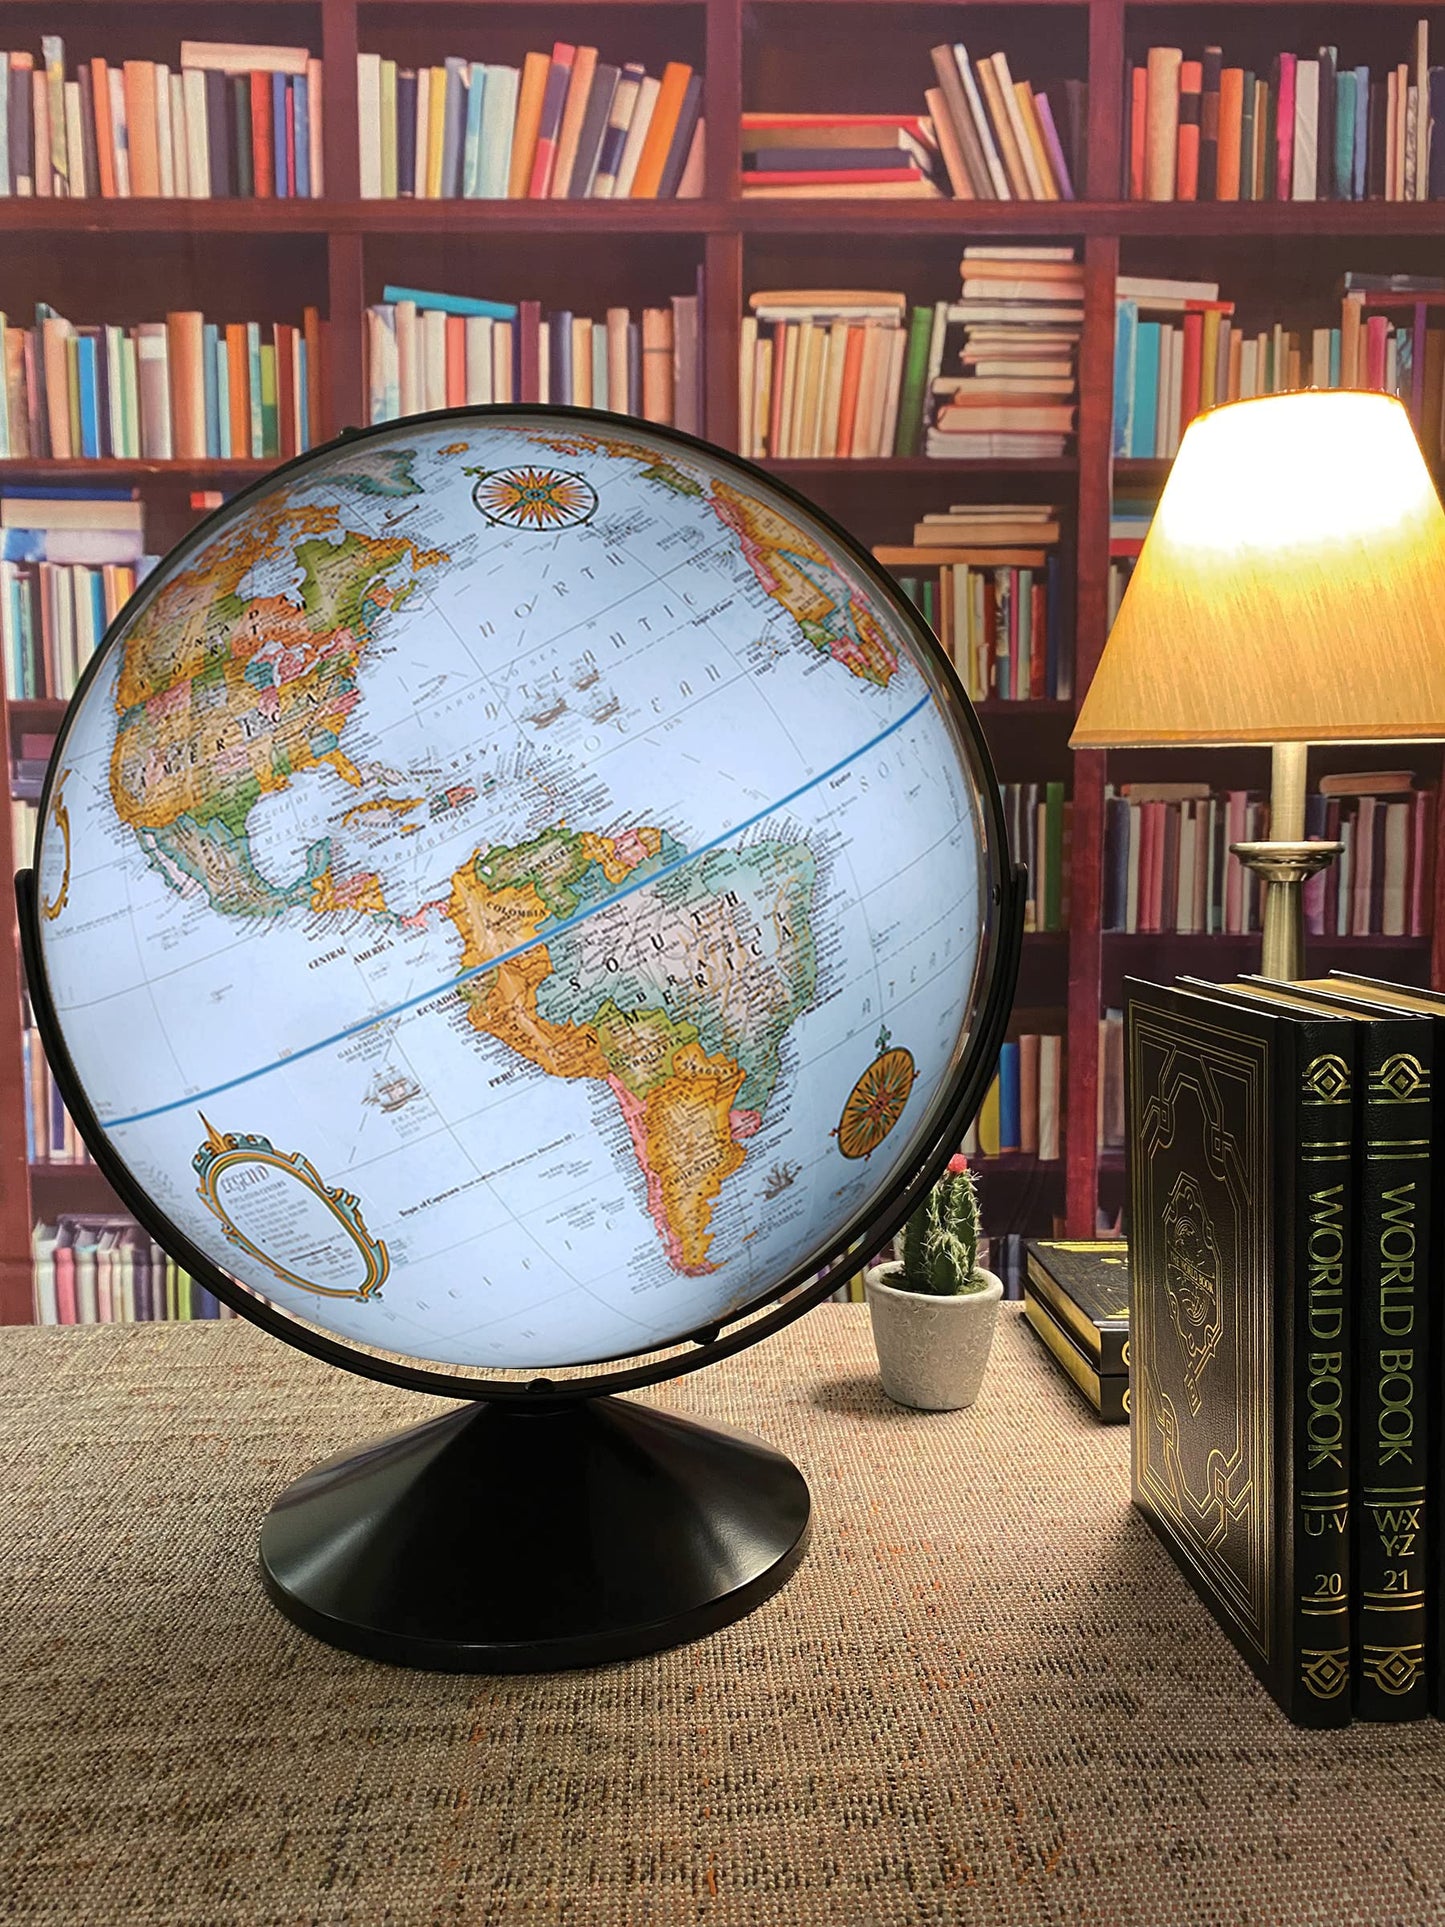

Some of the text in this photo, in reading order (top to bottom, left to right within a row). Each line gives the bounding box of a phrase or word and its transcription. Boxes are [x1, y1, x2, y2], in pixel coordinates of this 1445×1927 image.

[307, 937, 394, 971] CENTRAL AMERICA
[569, 890, 740, 992] SOUTH
[636, 911, 787, 1003] BRAZIL
[415, 987, 463, 1017] ECUADOR
[585, 925, 792, 1047] AMERICA
[630, 1035, 683, 1068] BOLIVIA
[487, 1069, 516, 1088] PERU
[219, 1161, 270, 1198] LEGEND
[666, 1152, 726, 1187] ARGENTINA
[398, 1203, 419, 1219] Tropic
[1307, 1184, 1344, 1470] WORLD BOOK
[1378, 1182, 1416, 1467] WORLD BOOK
[1313, 1573, 1342, 1596] 20
[1383, 1570, 1409, 1592] 21
